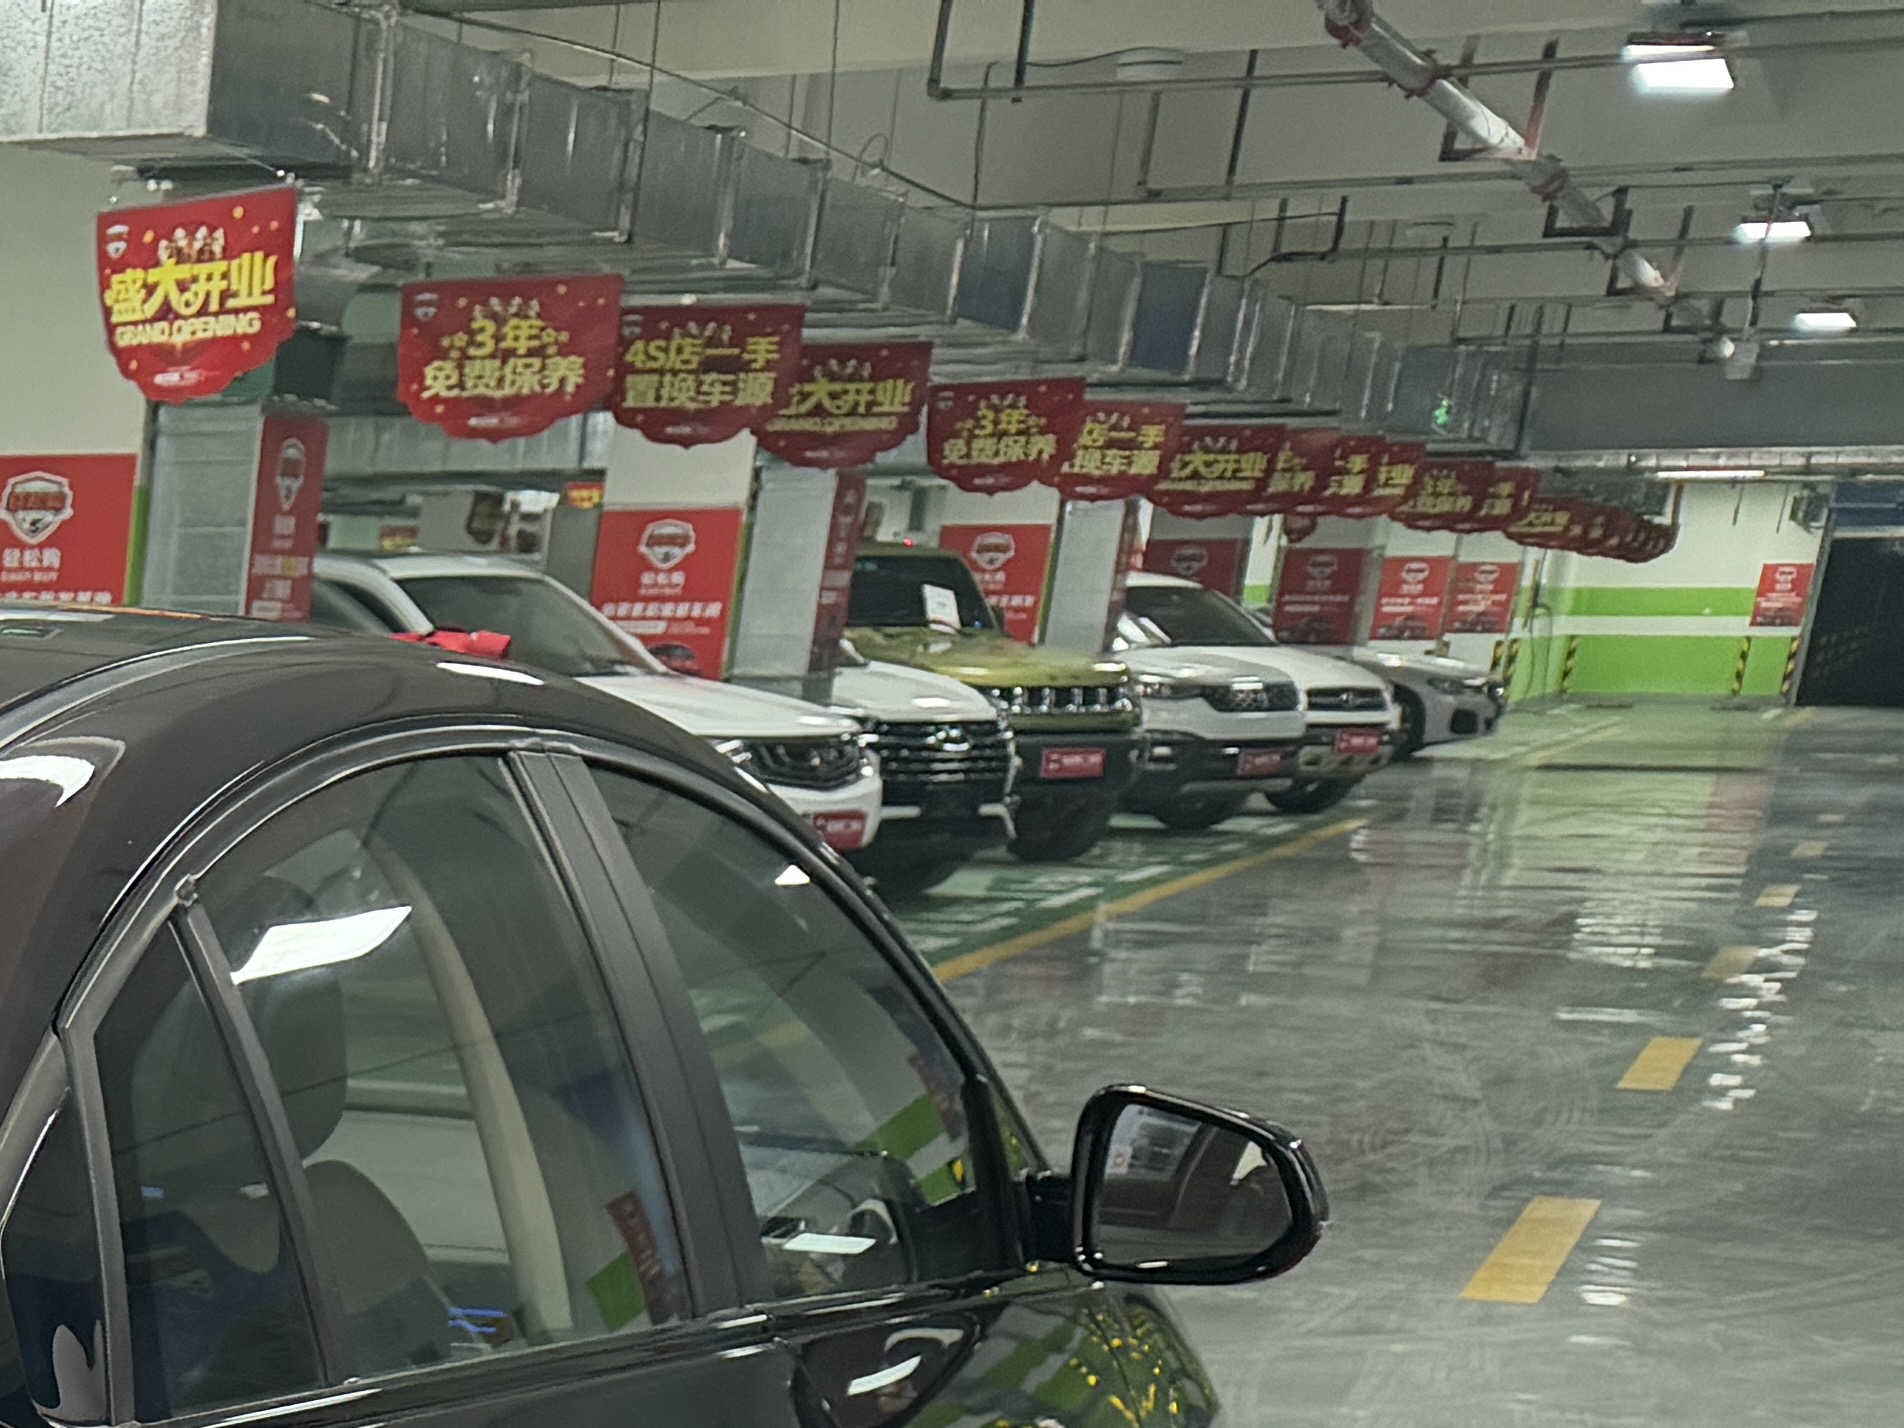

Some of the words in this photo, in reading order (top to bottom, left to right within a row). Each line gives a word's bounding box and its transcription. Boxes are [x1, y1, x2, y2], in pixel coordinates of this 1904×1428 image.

[104, 251, 278, 324] 盛大开业
[114, 320, 170, 347] GRAND
[172, 311, 261, 342] OPENING
[468, 316, 545, 356] 3年
[624, 335, 781, 371] 4S店一手
[421, 356, 587, 400] 免费保养
[779, 377, 916, 417] 大开业
